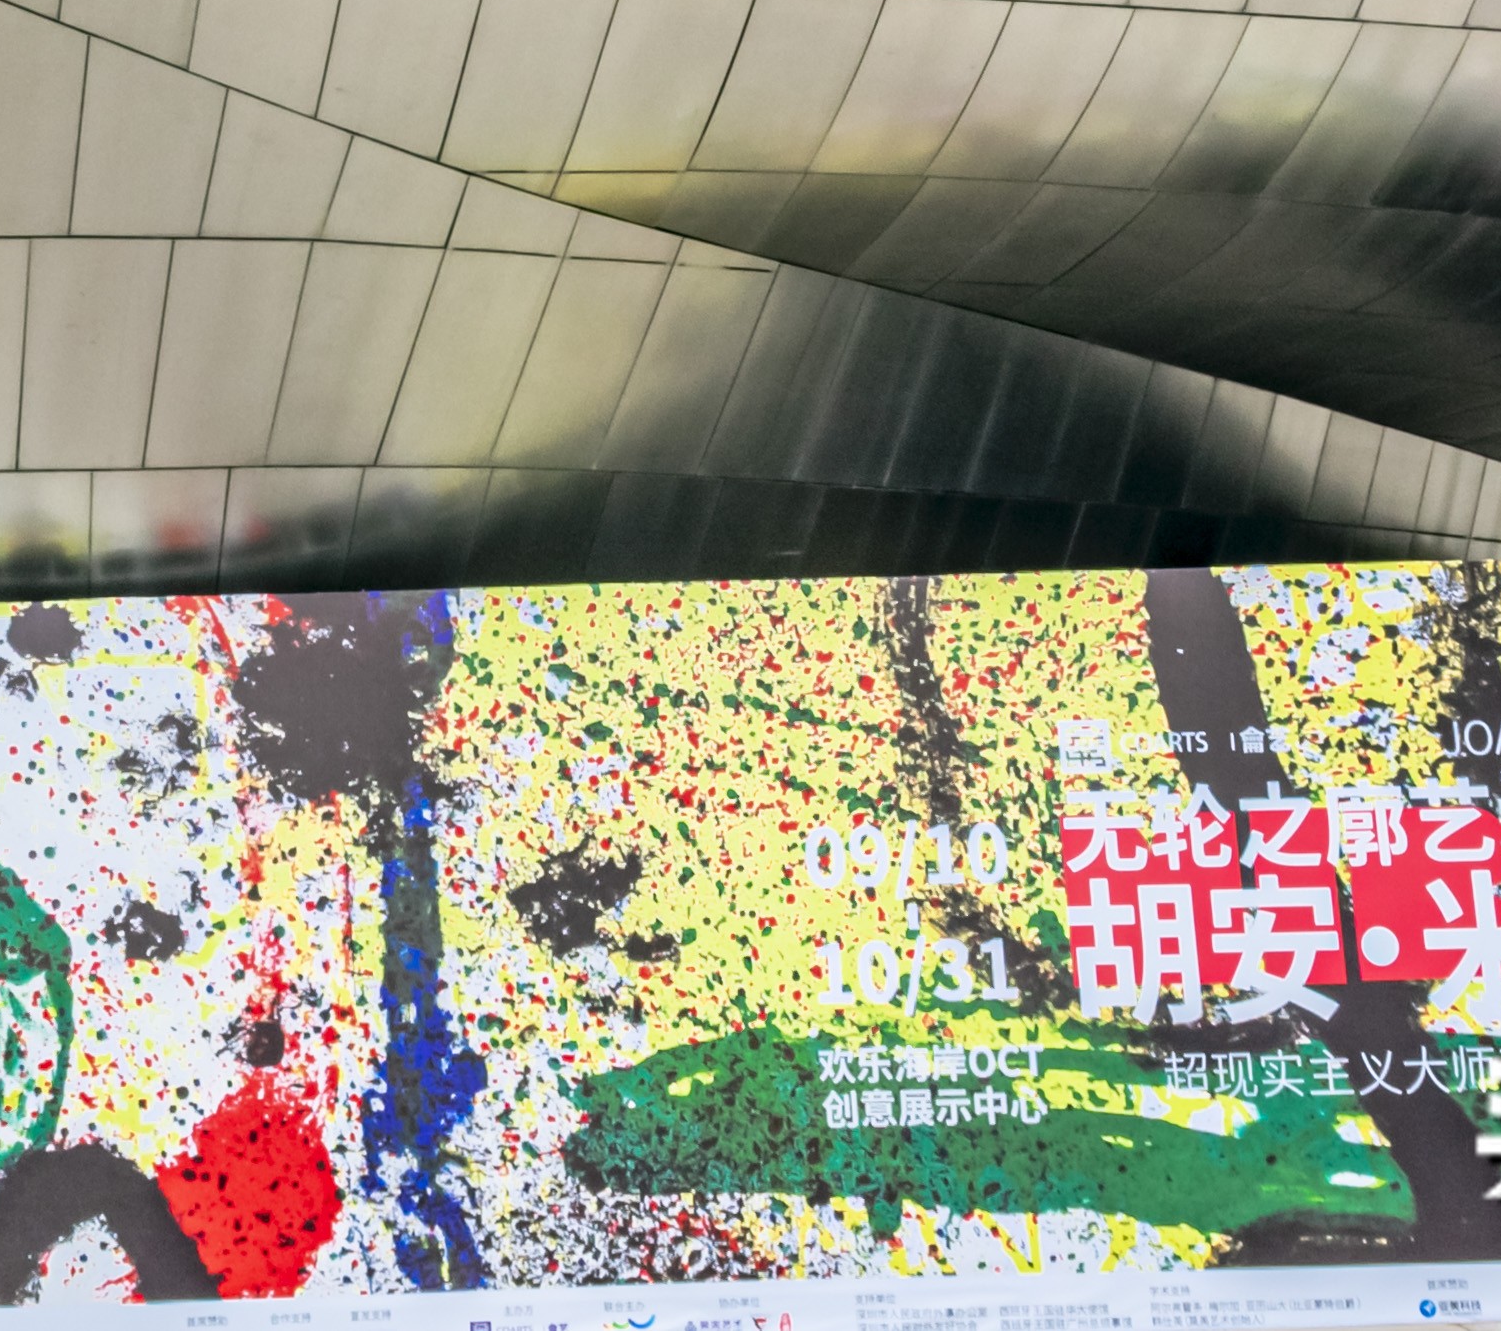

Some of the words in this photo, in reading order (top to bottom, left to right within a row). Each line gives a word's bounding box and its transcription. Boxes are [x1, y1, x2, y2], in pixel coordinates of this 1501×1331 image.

[804, 819, 1008, 900] 09/10
[817, 935, 1019, 1017] 10/31
[818, 1043, 1044, 1085] 欢乐海岸OCT
[822, 1084, 1048, 1130] 创意展示中心
